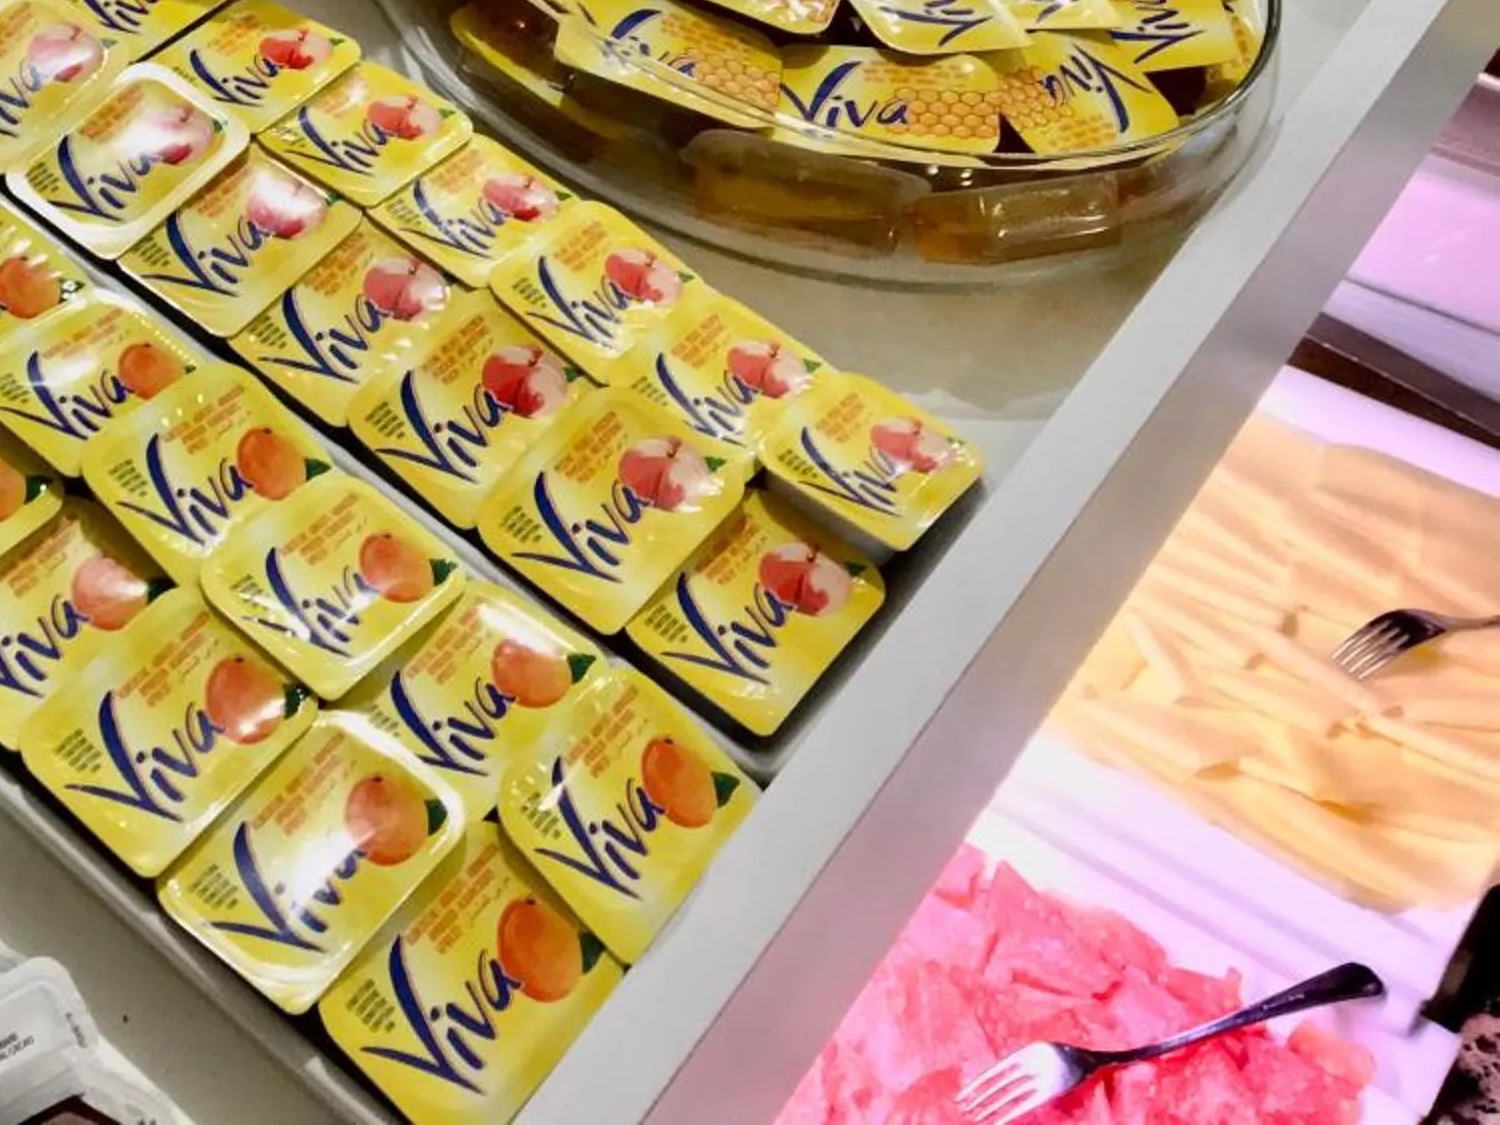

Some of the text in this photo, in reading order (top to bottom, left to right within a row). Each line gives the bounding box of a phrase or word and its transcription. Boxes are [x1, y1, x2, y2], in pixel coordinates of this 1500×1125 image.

[190, 49, 281, 107] Viva
[781, 61, 909, 128] Viva
[1039, 44, 1153, 134] Viva
[37, 136, 160, 223] Viva
[284, 107, 391, 175] Viva
[143, 212, 274, 295] Viva
[400, 178, 510, 260] Viva
[258, 288, 393, 384] Viva
[527, 257, 635, 356] Viva
[0, 352, 131, 440] Viva
[375, 372, 513, 483] Viva
[656, 354, 760, 445] Viva
[116, 434, 258, 546] Viva
[798, 429, 902, 517] Viva
[511, 472, 653, 583] Viva
[243, 547, 374, 658] Viva
[660, 572, 797, 685] Viva
[65, 691, 225, 822] Viva
[389, 670, 516, 776] Viva
[535, 756, 667, 899] Viva
[360, 935, 522, 1094] Viva
